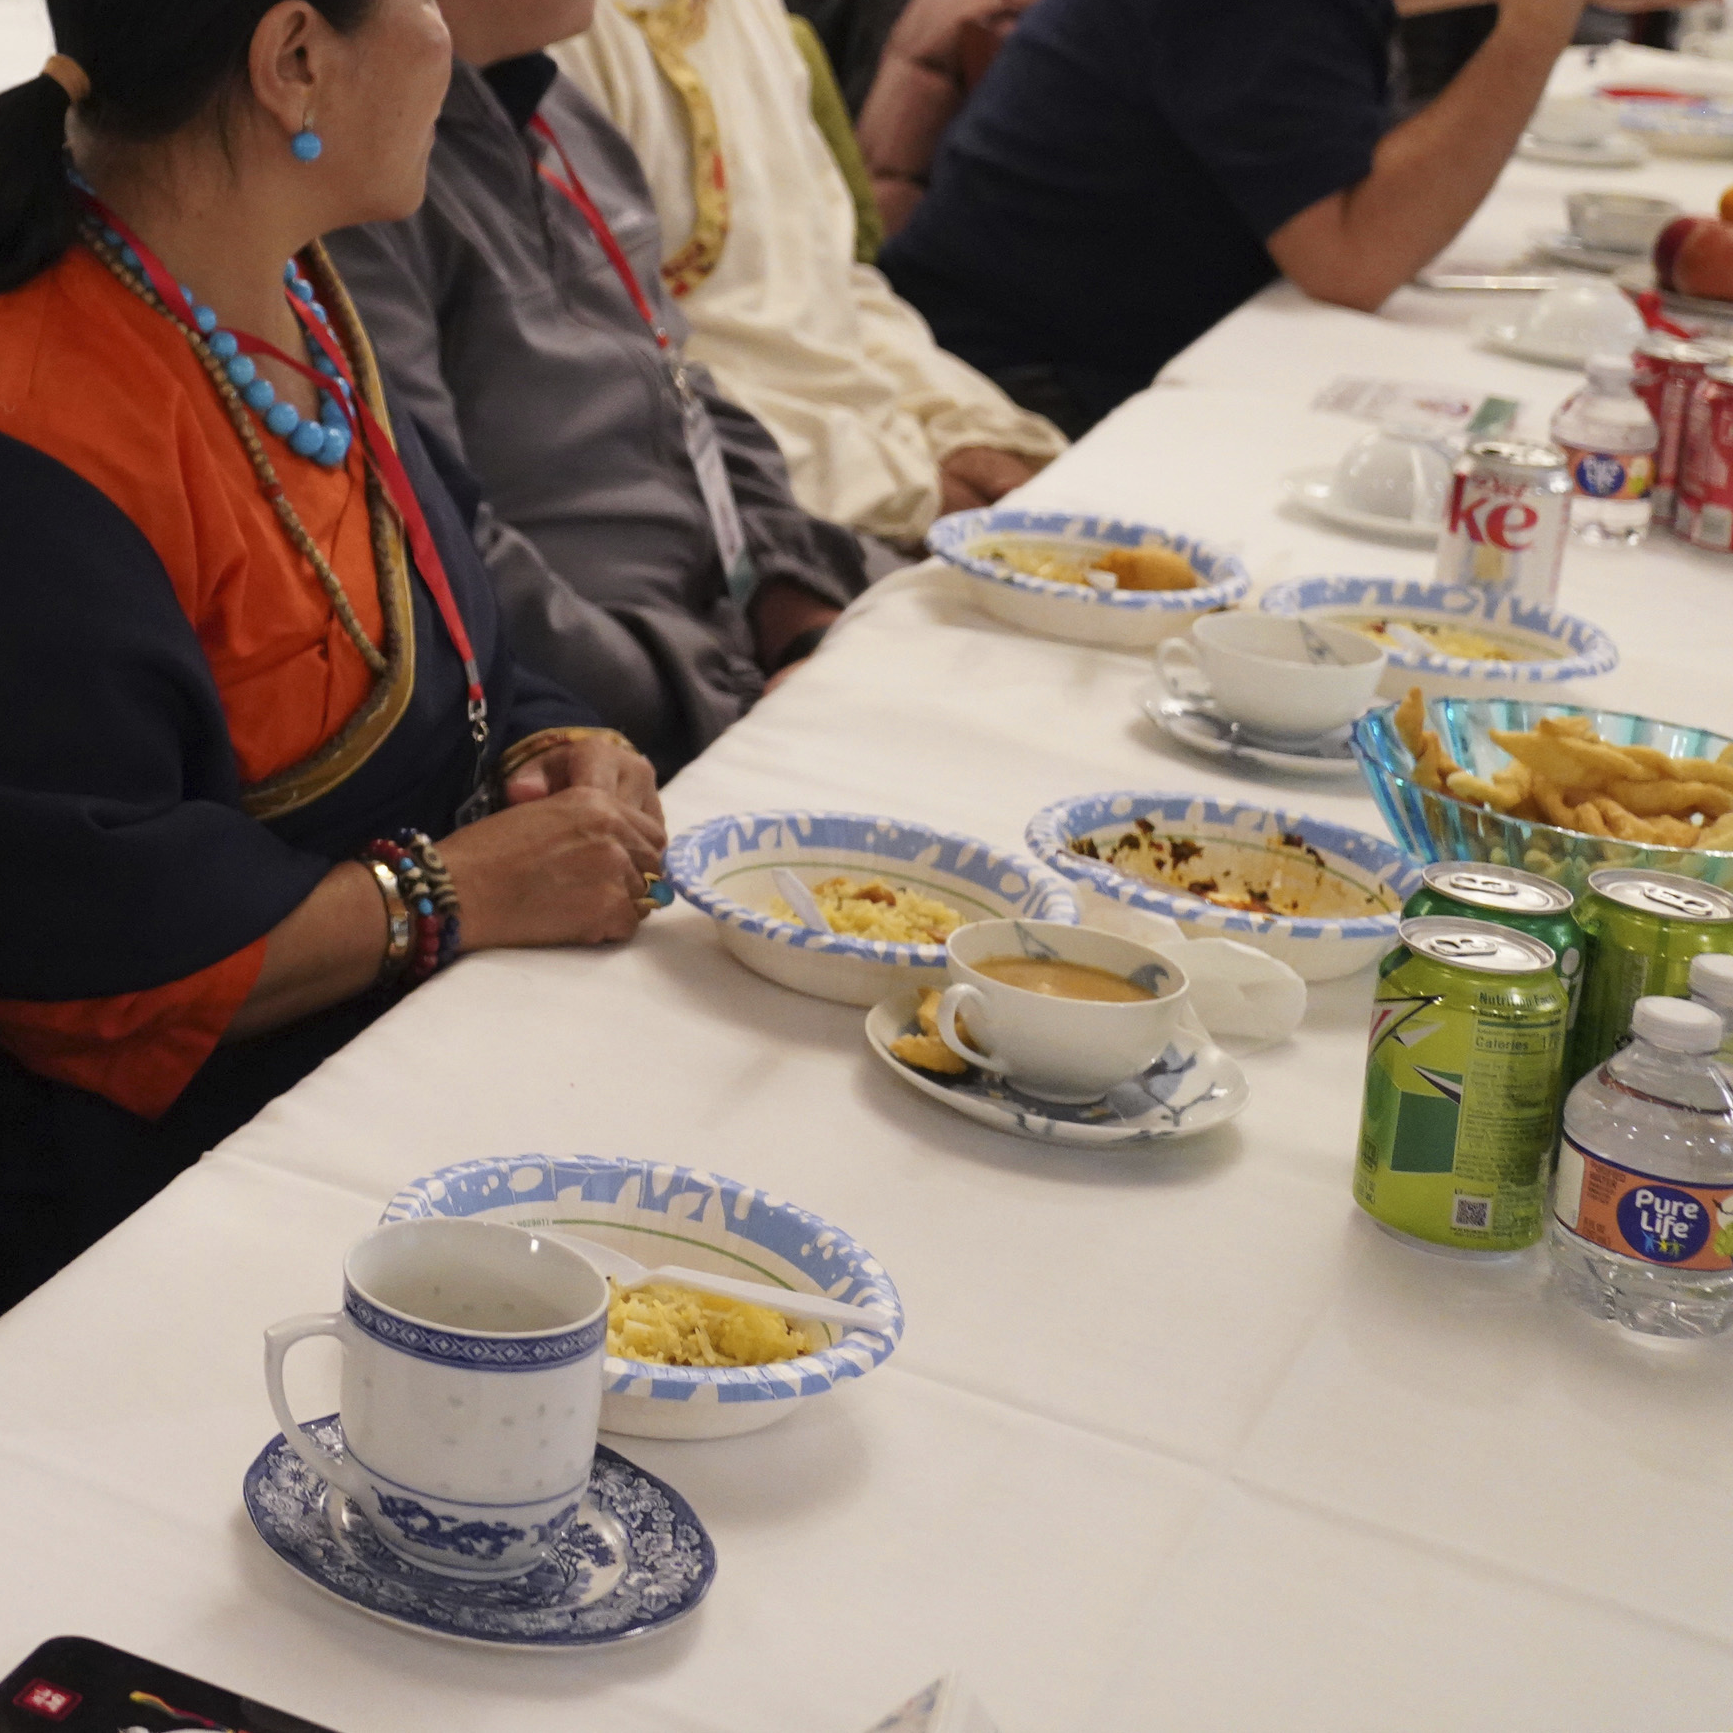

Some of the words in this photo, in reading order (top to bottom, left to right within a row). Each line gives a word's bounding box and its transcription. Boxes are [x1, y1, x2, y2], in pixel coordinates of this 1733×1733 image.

[1475, 1035, 1529, 1050] Calories
[1635, 1188, 1700, 1220] Pure
[1640, 1210, 1689, 1240] Life
